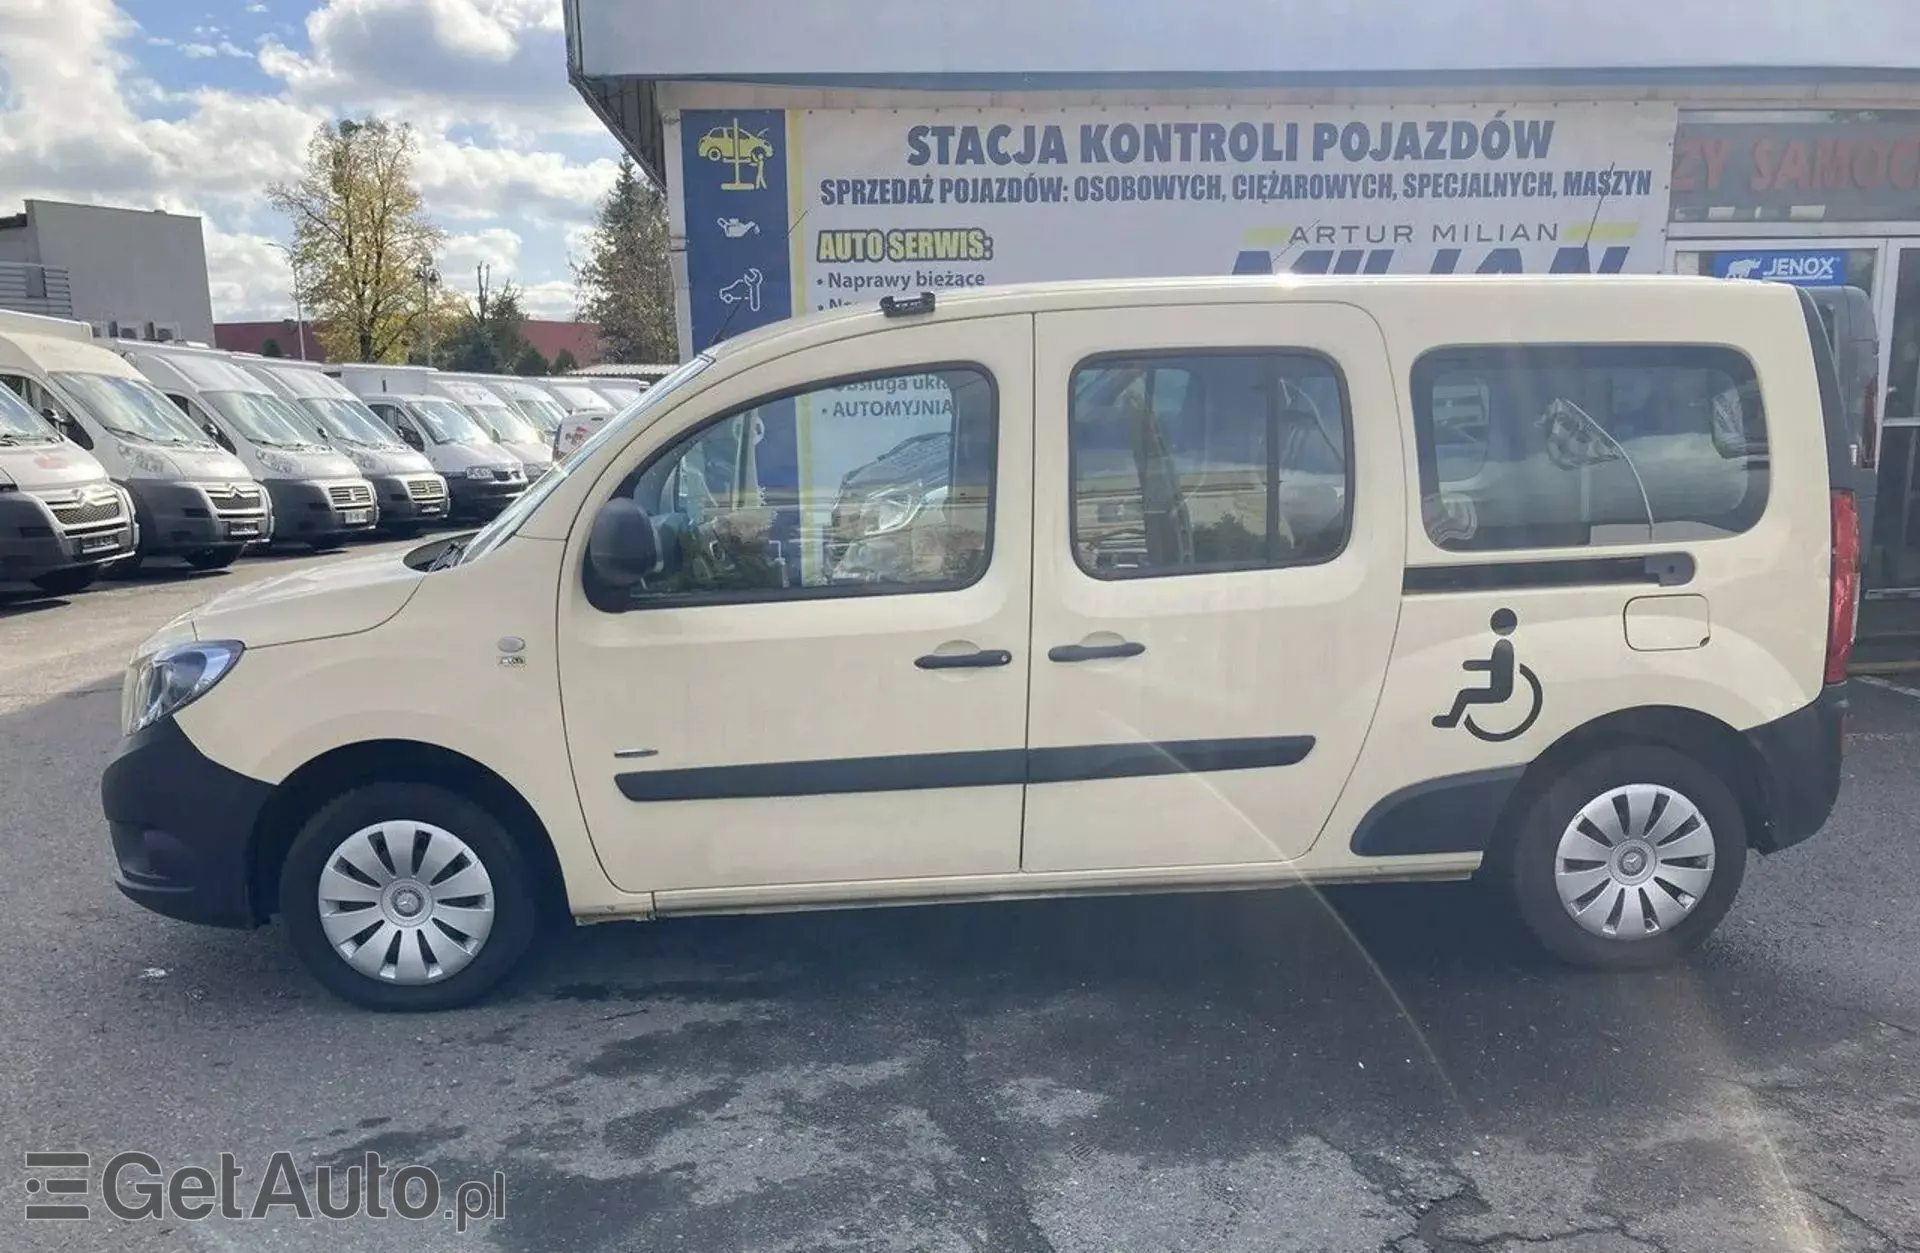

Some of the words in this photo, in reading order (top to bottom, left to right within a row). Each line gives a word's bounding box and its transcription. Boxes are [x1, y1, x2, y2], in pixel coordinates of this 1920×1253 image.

[907, 124, 1068, 166] STACJA
[1080, 122, 1298, 164] KONTROLI
[1312, 110, 1555, 162] POJAZDÓW
[820, 173, 934, 206] SPRZEDAŻ
[939, 172, 1069, 204] POJAZDÓW:
[1074, 174, 1226, 202] OSOBOWYCH,
[1232, 170, 1397, 203] CIĘŻAROWYCH,
[1403, 171, 1557, 199] SPECJALNYCH,
[1563, 169, 1652, 196] MASZYN
[817, 230, 884, 262] AUTO
[886, 228, 993, 262] SERWIS:
[1288, 225, 1414, 245] ARTUR
[1432, 223, 1559, 243] MILIAN
[828, 272, 911, 292] Naprawy
[916, 270, 985, 288] bieżące
[833, 399, 952, 417] AUTOMYJNIA
